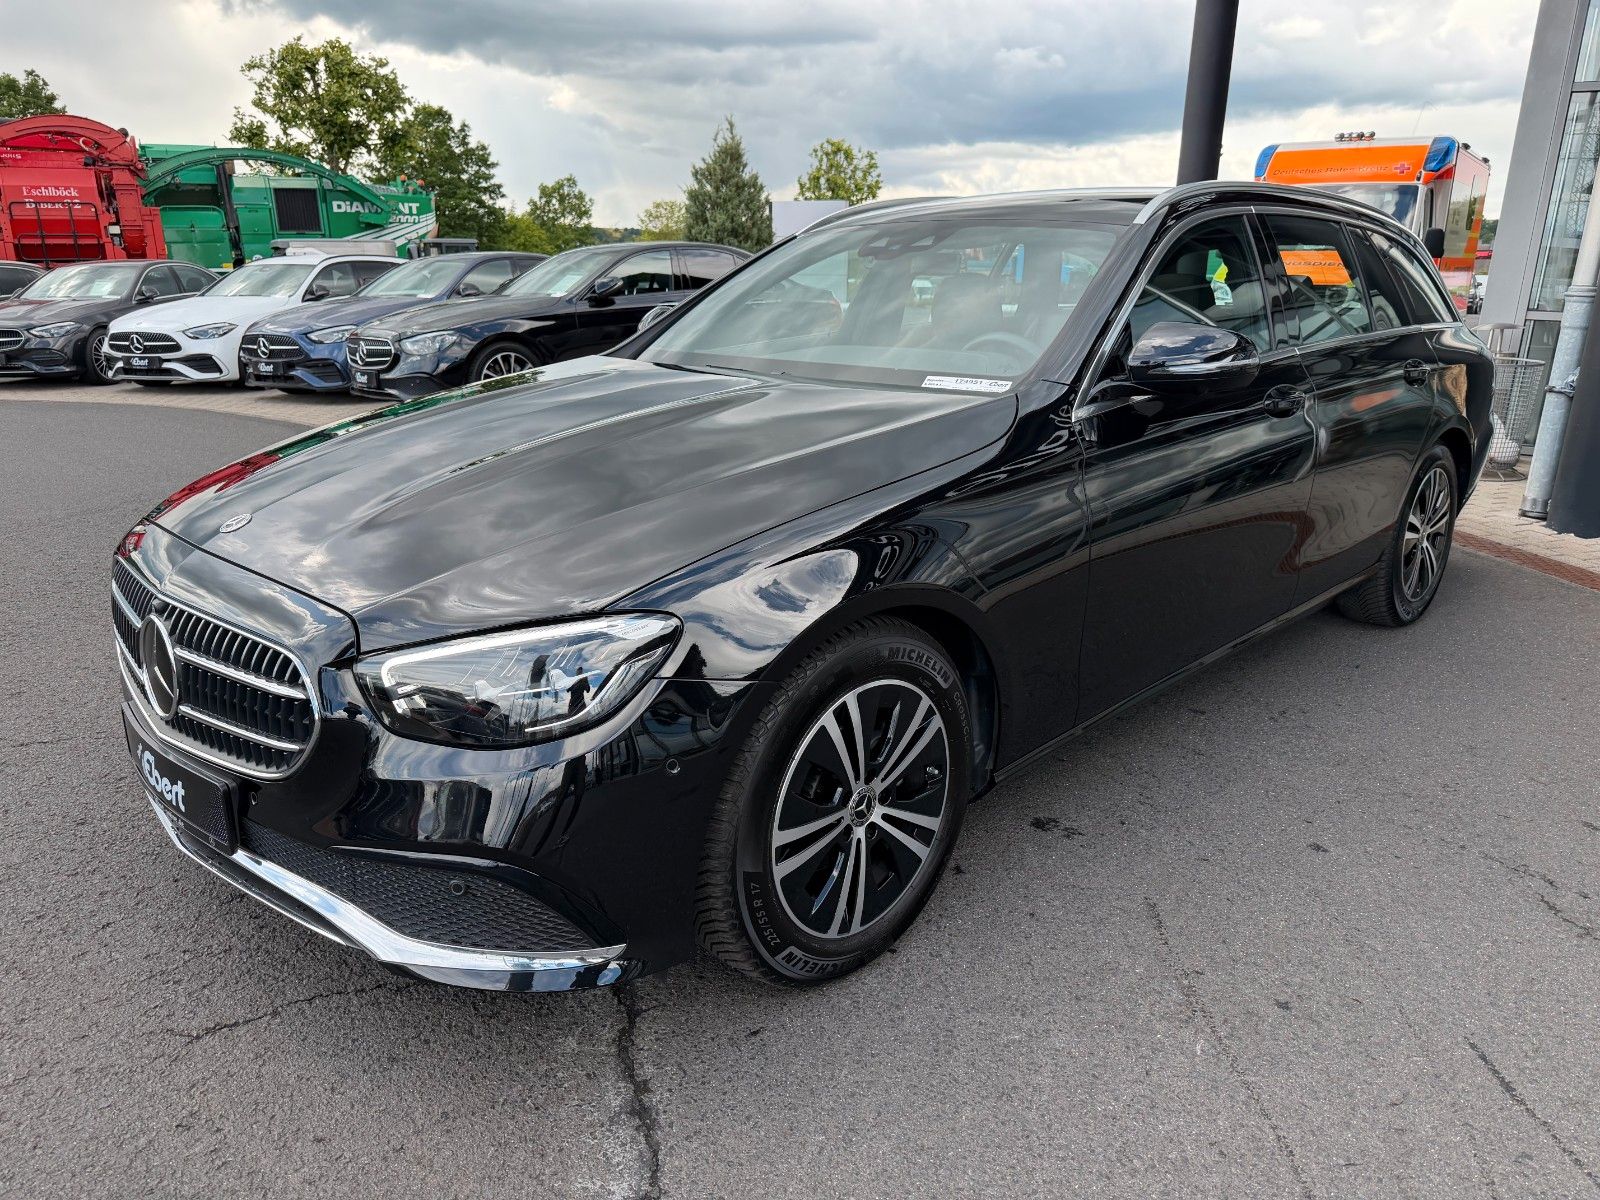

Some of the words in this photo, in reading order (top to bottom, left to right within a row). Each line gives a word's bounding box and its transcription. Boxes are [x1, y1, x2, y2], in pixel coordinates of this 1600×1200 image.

[22, 186, 79, 197] Eschlböck
[888, 646, 951, 684] MICHELIN
[141, 750, 186, 813] Ebert
[749, 882, 761, 894] 17
[752, 899, 764, 909] R
[755, 910, 782, 946] 225/55
